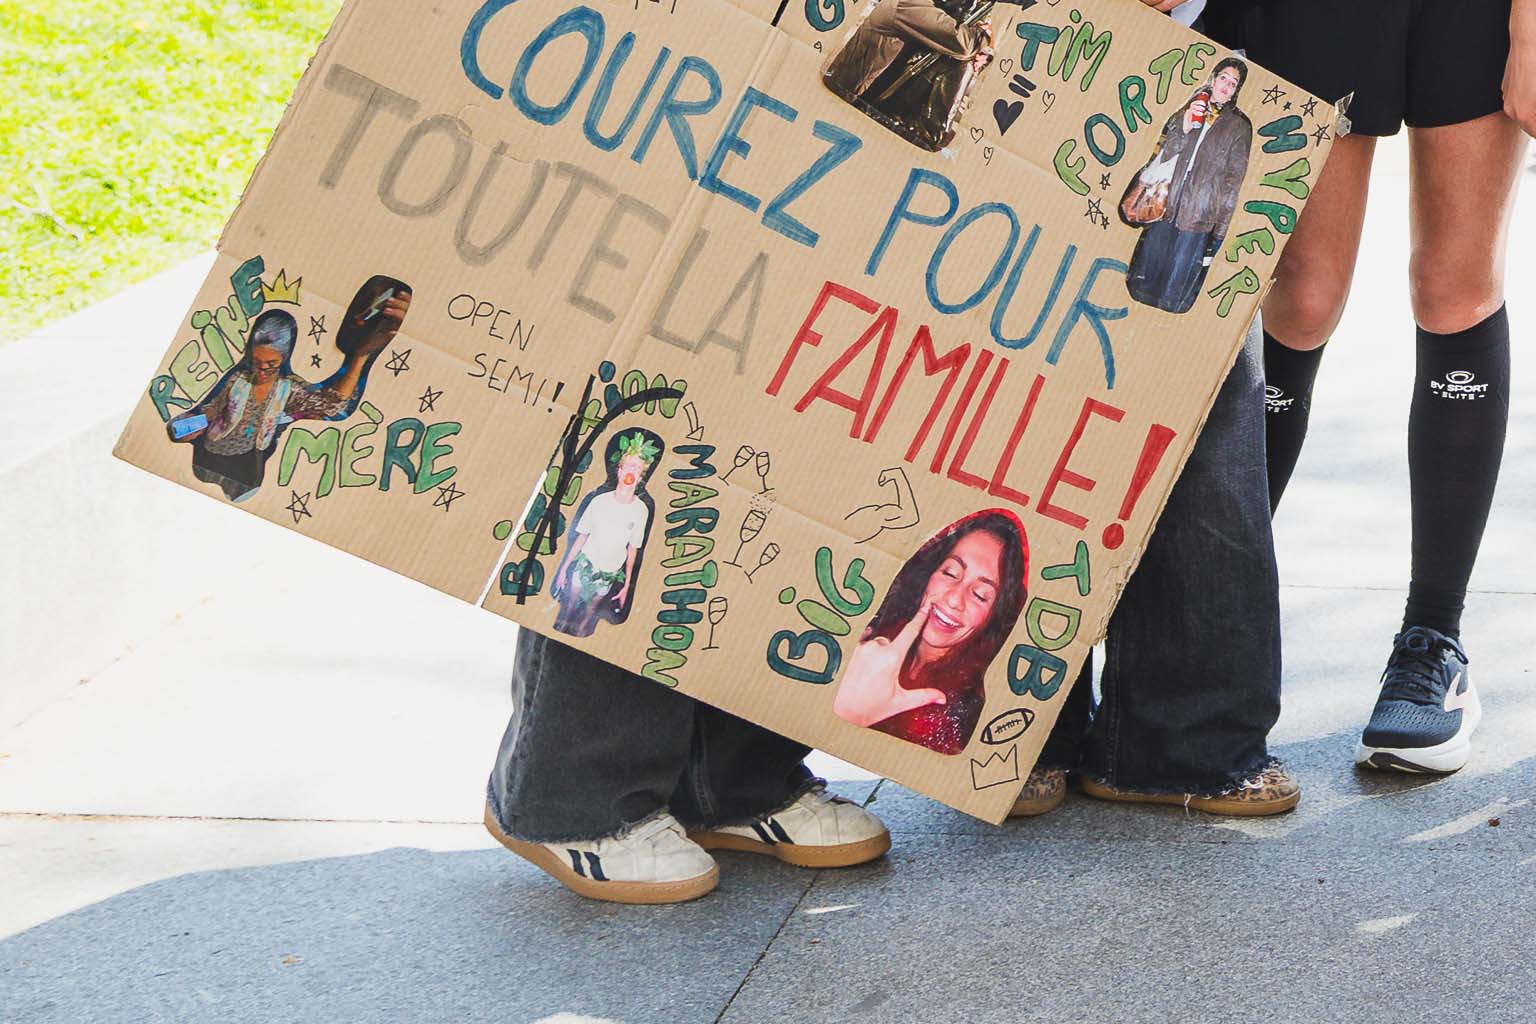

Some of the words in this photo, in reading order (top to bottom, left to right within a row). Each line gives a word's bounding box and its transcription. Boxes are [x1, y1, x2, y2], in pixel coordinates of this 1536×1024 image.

[320, 63, 671, 326] TOUTE
[647, 226, 771, 376] LA
[1052, 42, 1217, 197] FORTE
[1207, 114, 1311, 318] HYPER
[447, 293, 536, 352] OPEN
[863, 166, 1129, 391] POUR
[277, 400, 463, 499] MÈRE
[466, 352, 566, 415] SEMI!
[1447, 383, 1489, 393] SPORT
[641, 442, 721, 688] MARATHON
[1006, 540, 1092, 702] TDB
